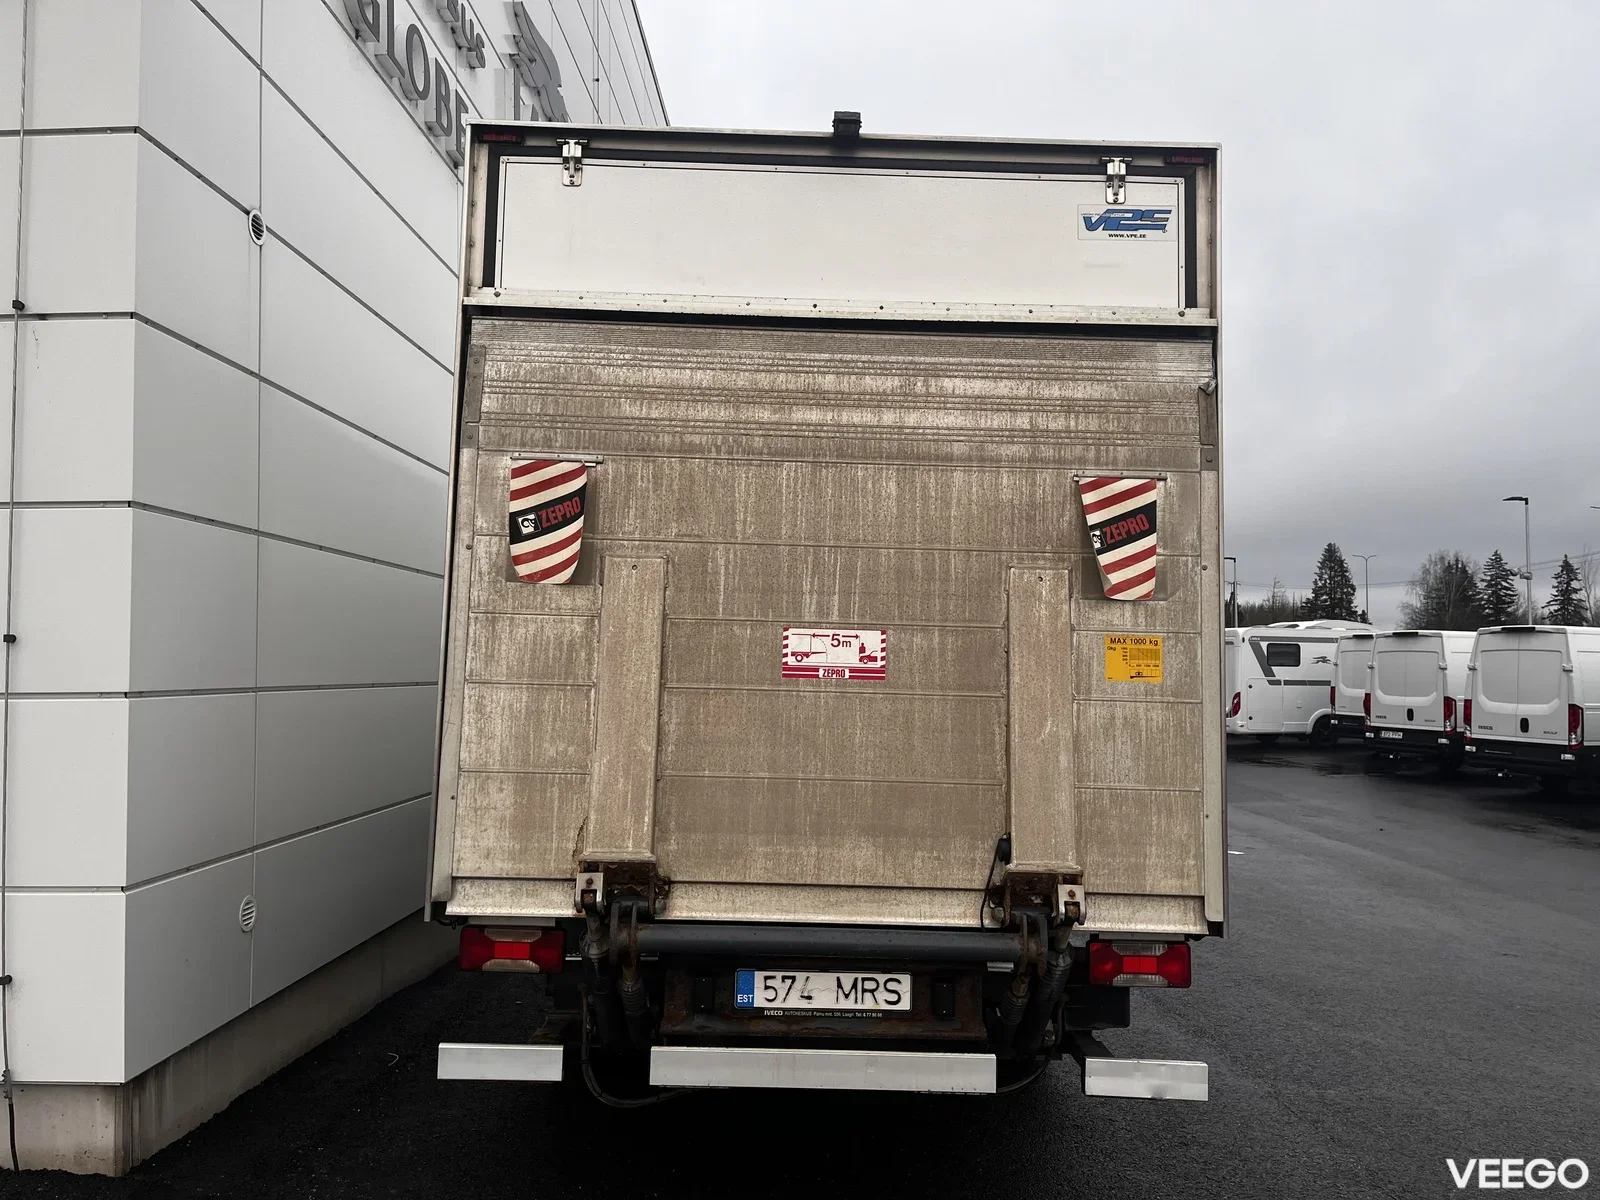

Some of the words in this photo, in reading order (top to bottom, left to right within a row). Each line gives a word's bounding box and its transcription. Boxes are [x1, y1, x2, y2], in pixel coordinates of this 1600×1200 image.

[538, 496, 582, 529] ZEPRO
[1103, 513, 1150, 545] ZEPRO
[1110, 637, 1127, 645] MAX
[1149, 638, 1159, 647] kg
[822, 668, 846, 678] ZEPRO
[737, 994, 754, 1003] EST
[835, 976, 903, 1006] MRS
